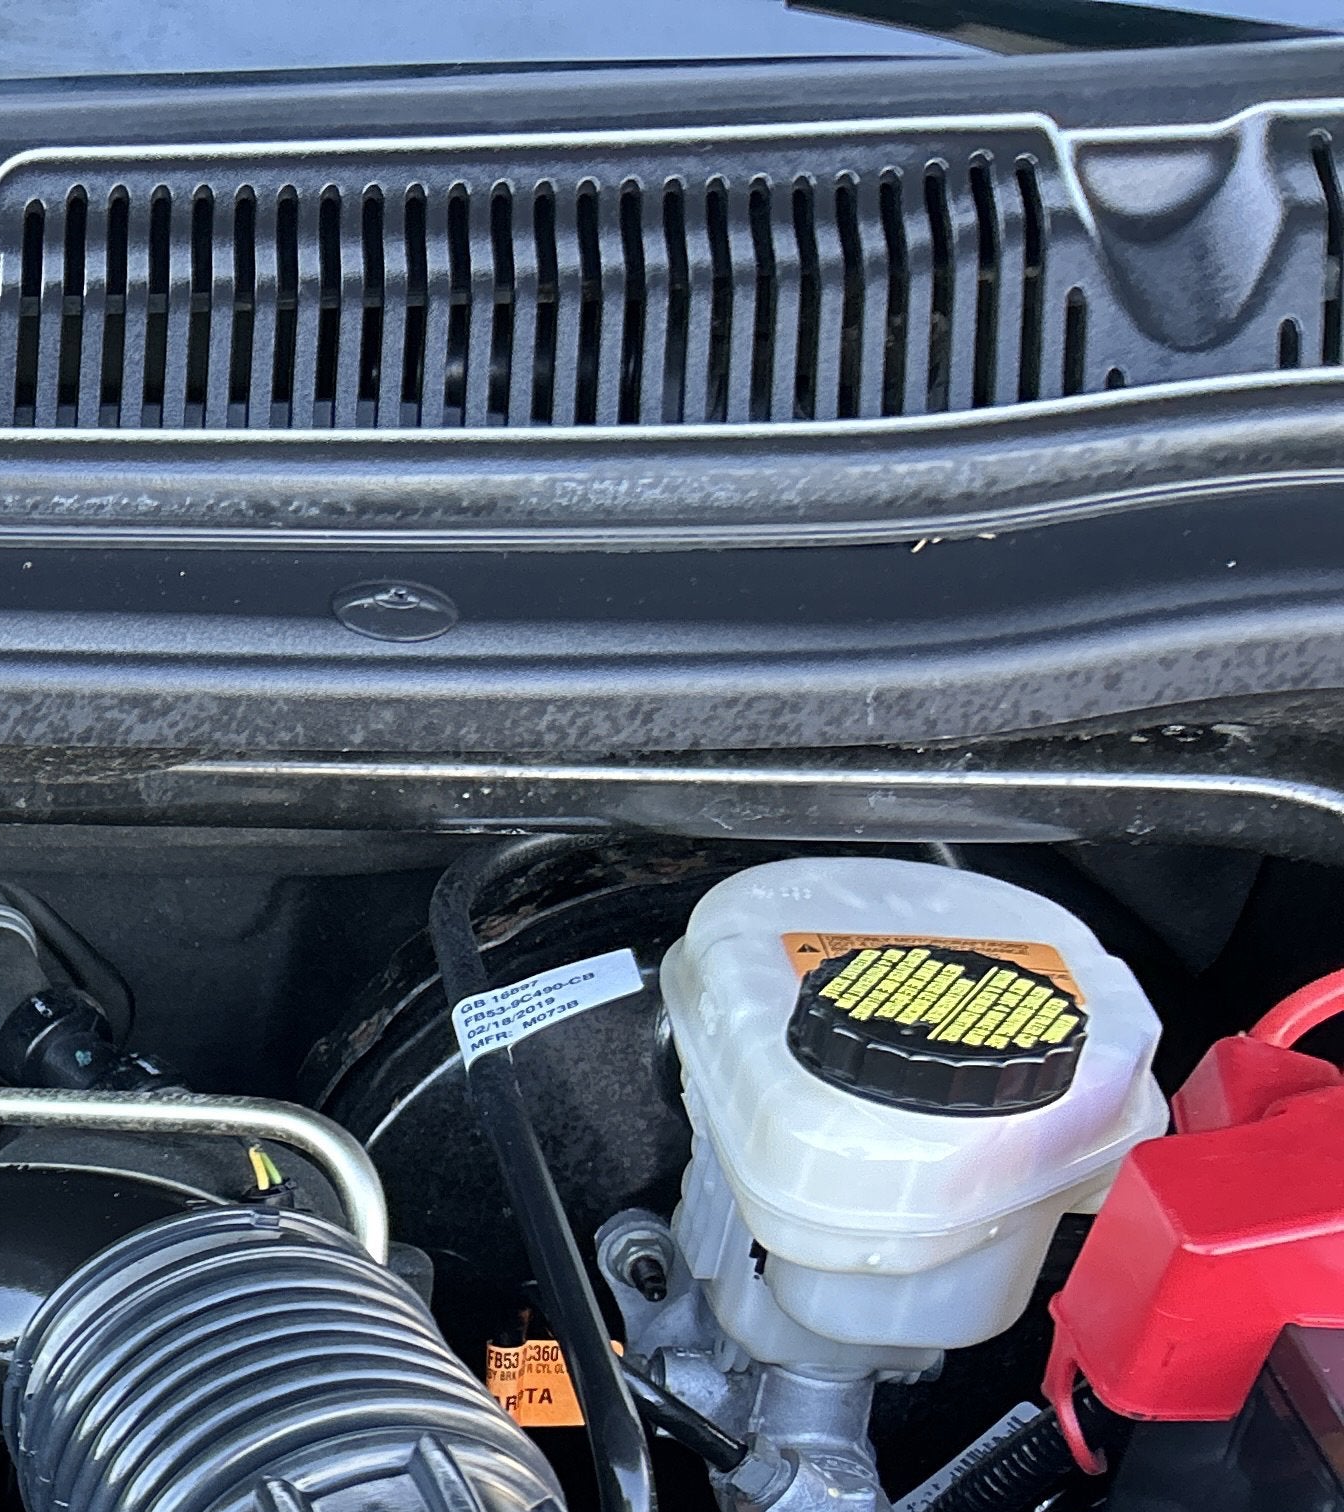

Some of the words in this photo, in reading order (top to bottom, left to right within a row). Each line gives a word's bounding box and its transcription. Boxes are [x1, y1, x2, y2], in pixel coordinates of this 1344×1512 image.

[460, 999, 486, 1015] GB
[467, 996, 556, 1040] 02/18/2019
[470, 1030, 514, 1053] MFR:
[522, 999, 580, 1030] M073B
